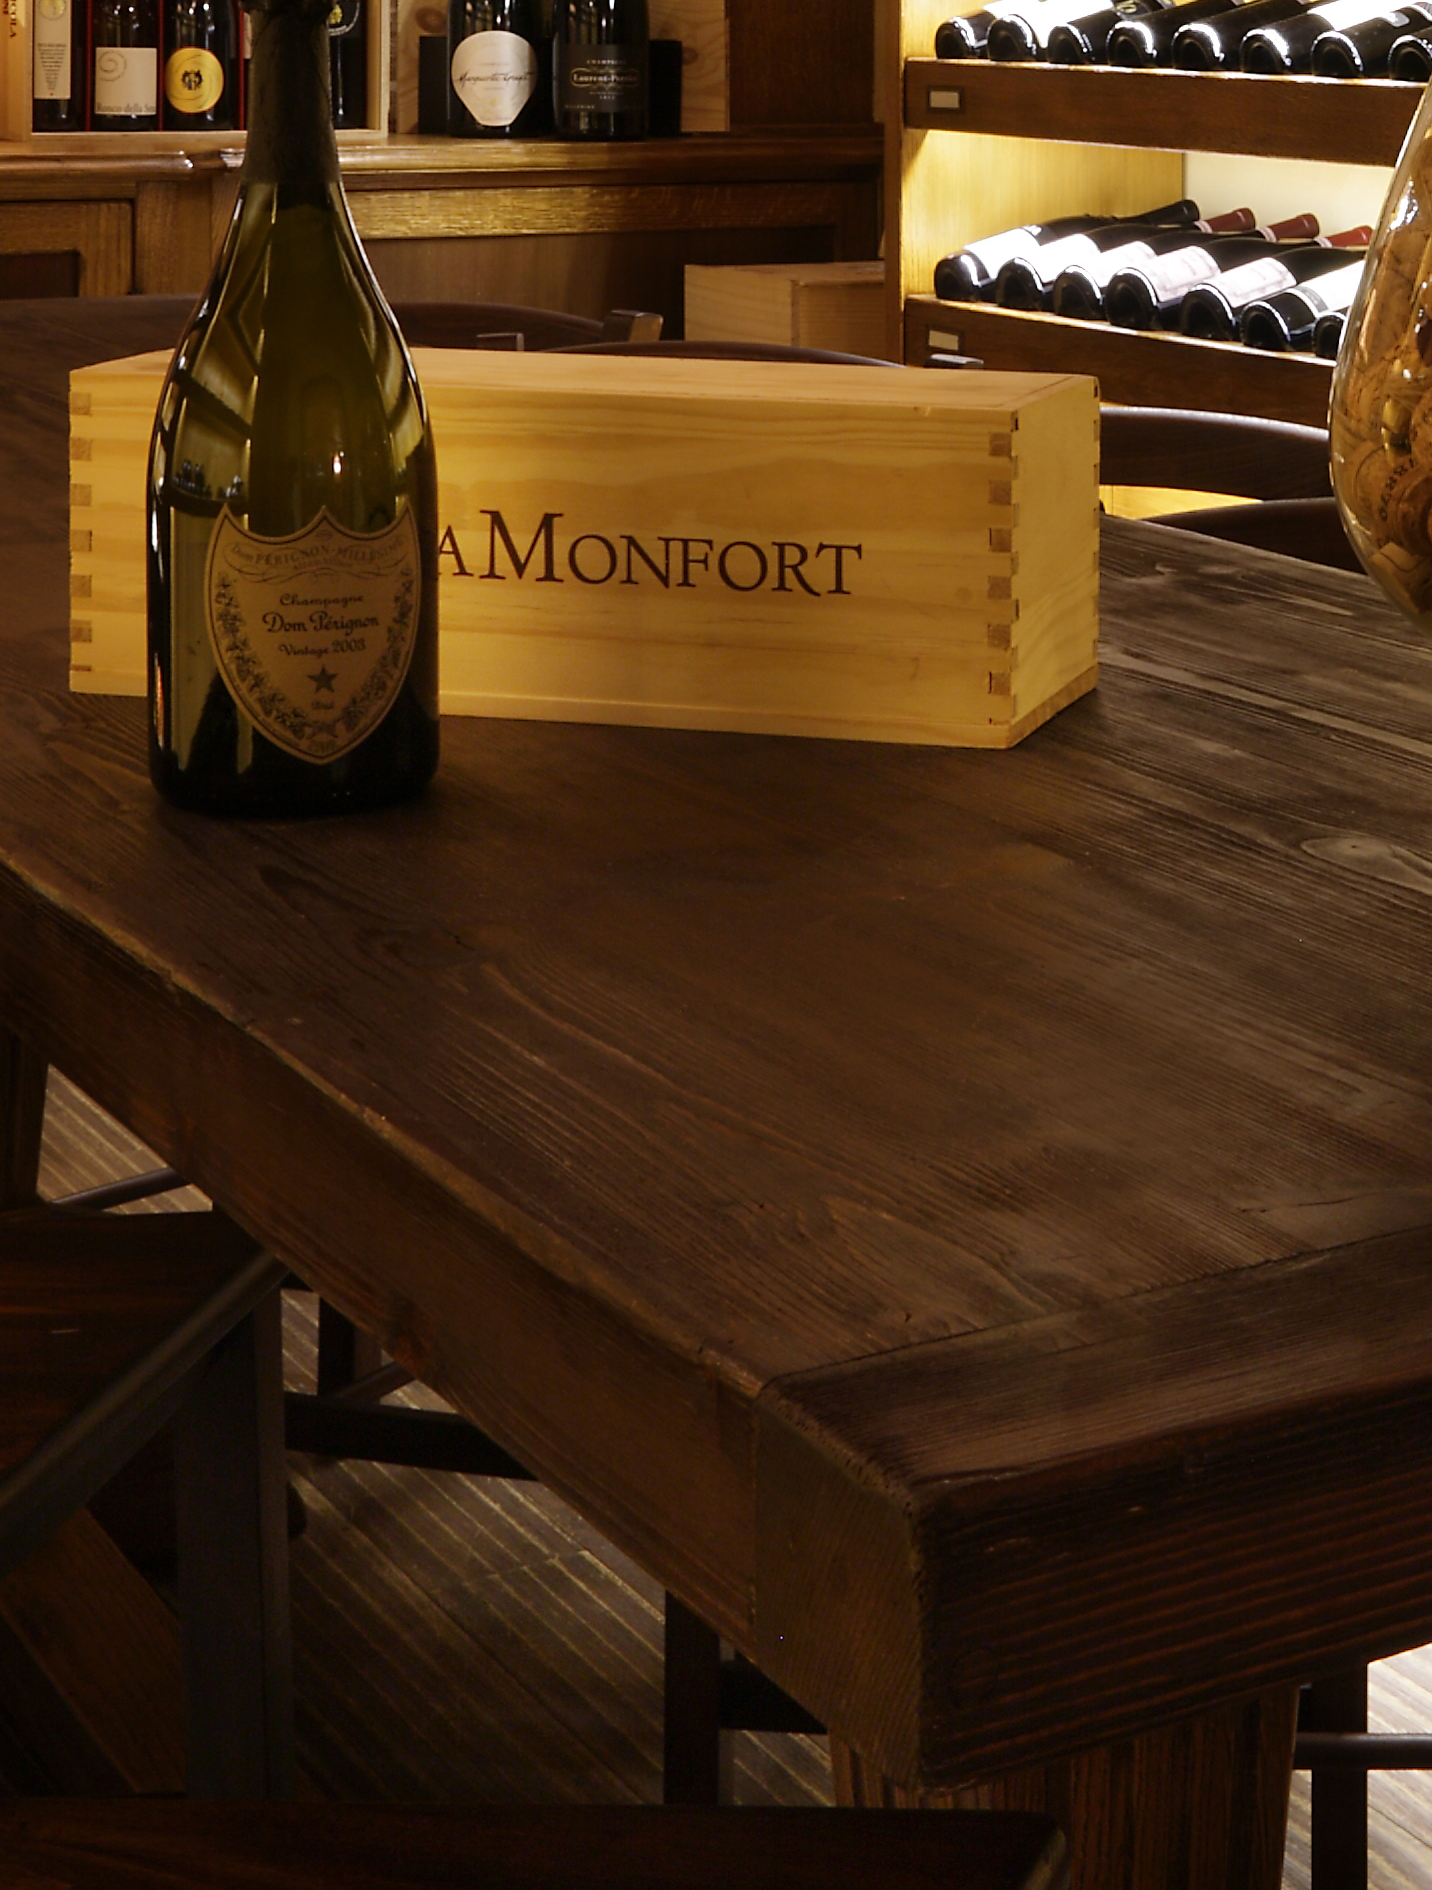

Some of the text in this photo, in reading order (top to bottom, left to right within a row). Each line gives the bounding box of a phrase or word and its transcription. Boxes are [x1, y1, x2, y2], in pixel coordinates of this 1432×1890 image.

[437, 509, 863, 598] AMONFORT
[280, 593, 364, 608] Champagne
[262, 611, 380, 637] Dom Pérignon
[279, 637, 367, 659] Vintage 2003
